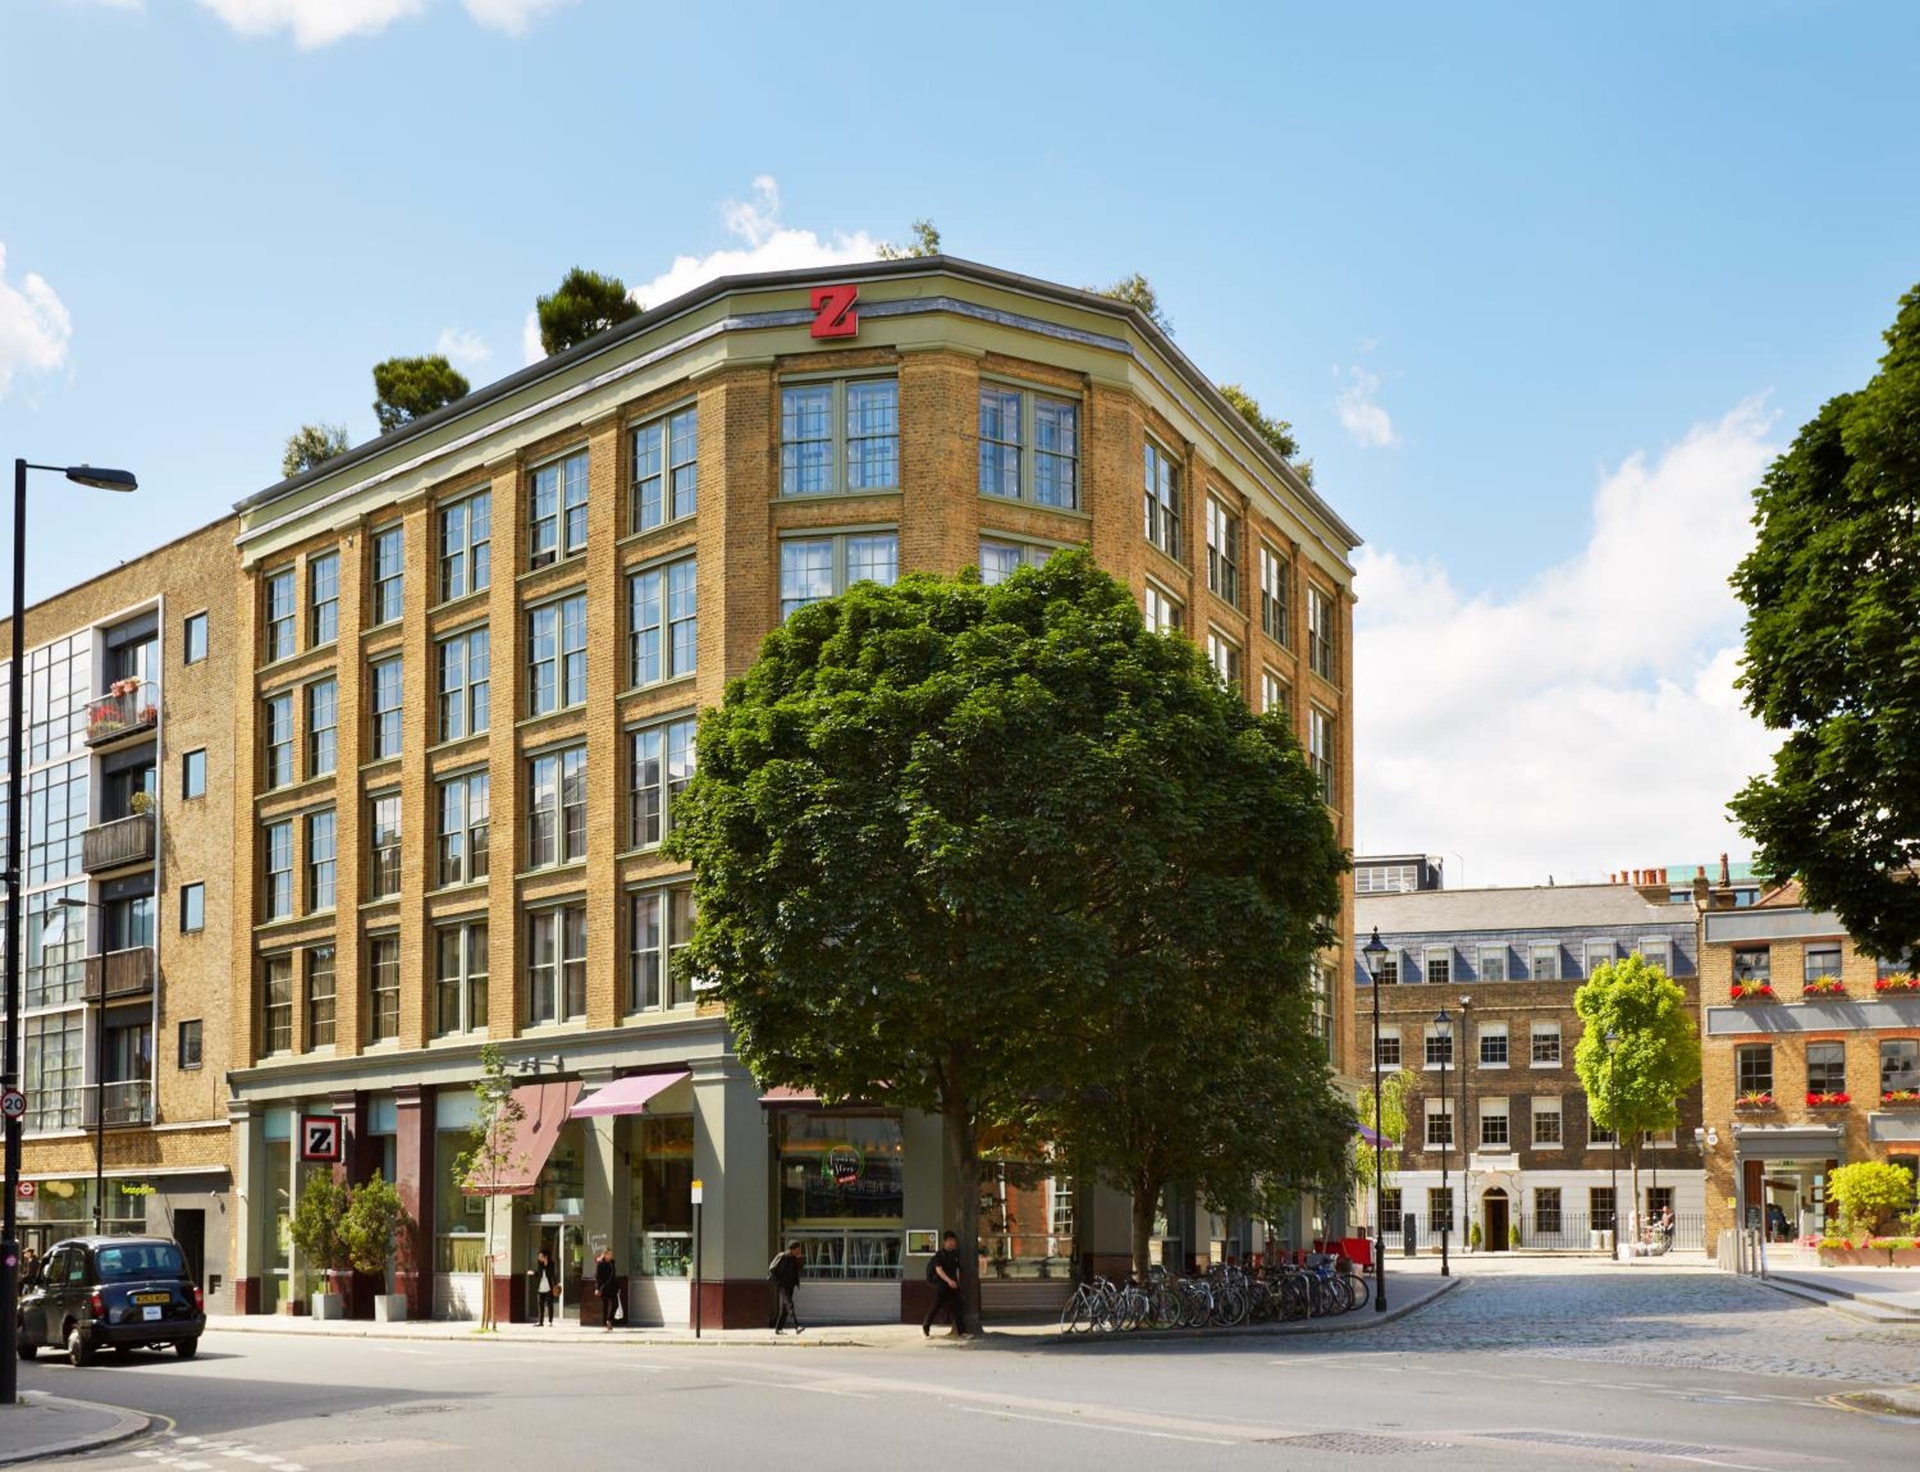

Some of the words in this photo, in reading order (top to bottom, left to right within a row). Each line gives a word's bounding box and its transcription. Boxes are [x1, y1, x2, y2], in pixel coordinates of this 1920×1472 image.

[810, 284, 859, 339] Z
[5, 1099, 22, 1110] 20
[310, 1128, 331, 1153] Z
